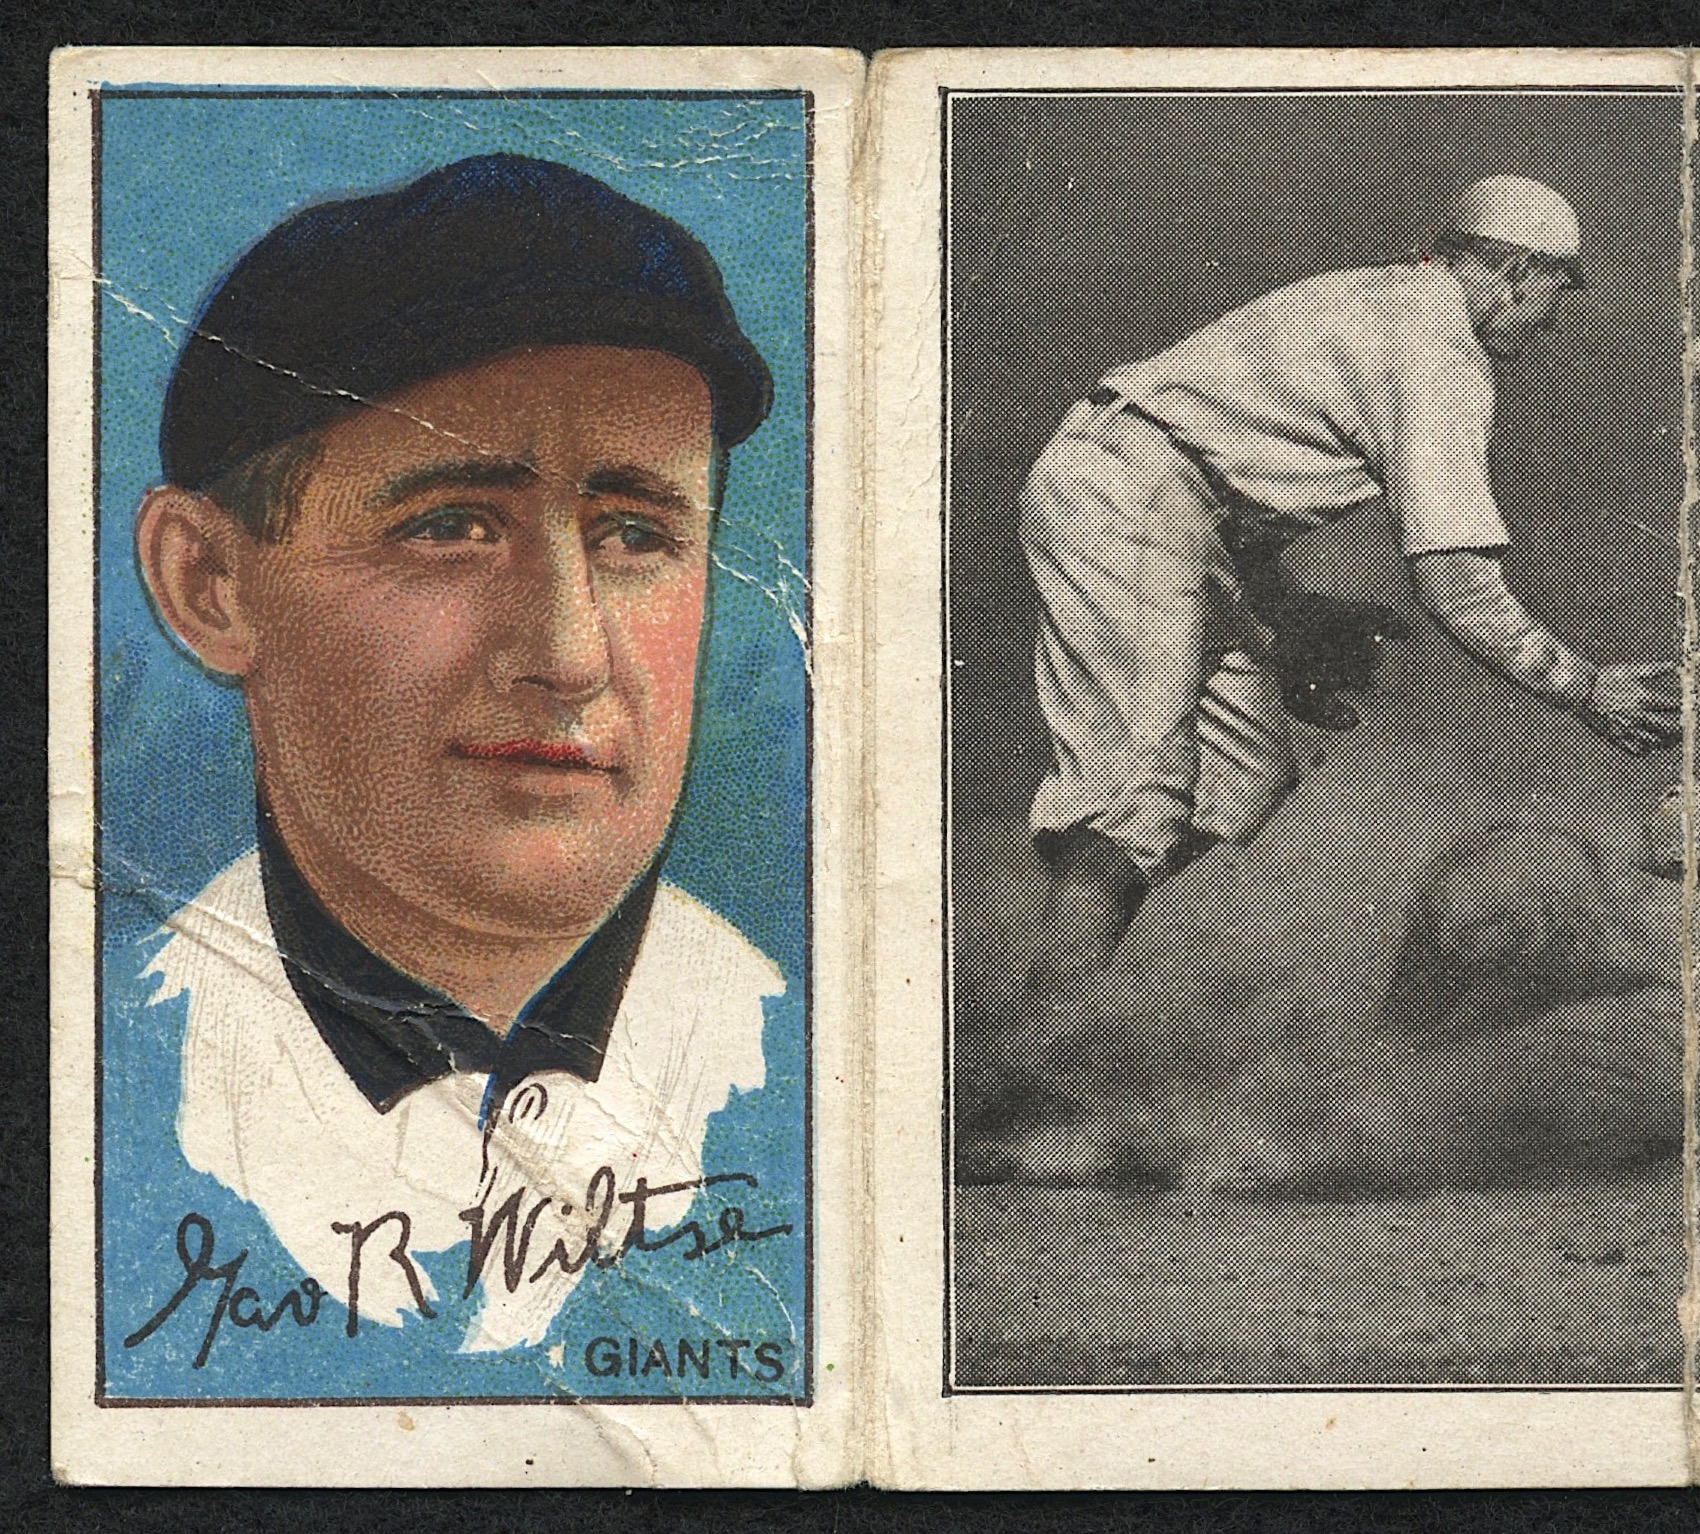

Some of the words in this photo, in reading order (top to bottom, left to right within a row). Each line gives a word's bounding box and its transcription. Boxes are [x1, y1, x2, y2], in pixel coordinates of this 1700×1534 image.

[331, 1210, 438, 1338] R
[458, 1165, 793, 1300] Wiltse
[584, 1335, 785, 1382] GIANTS
